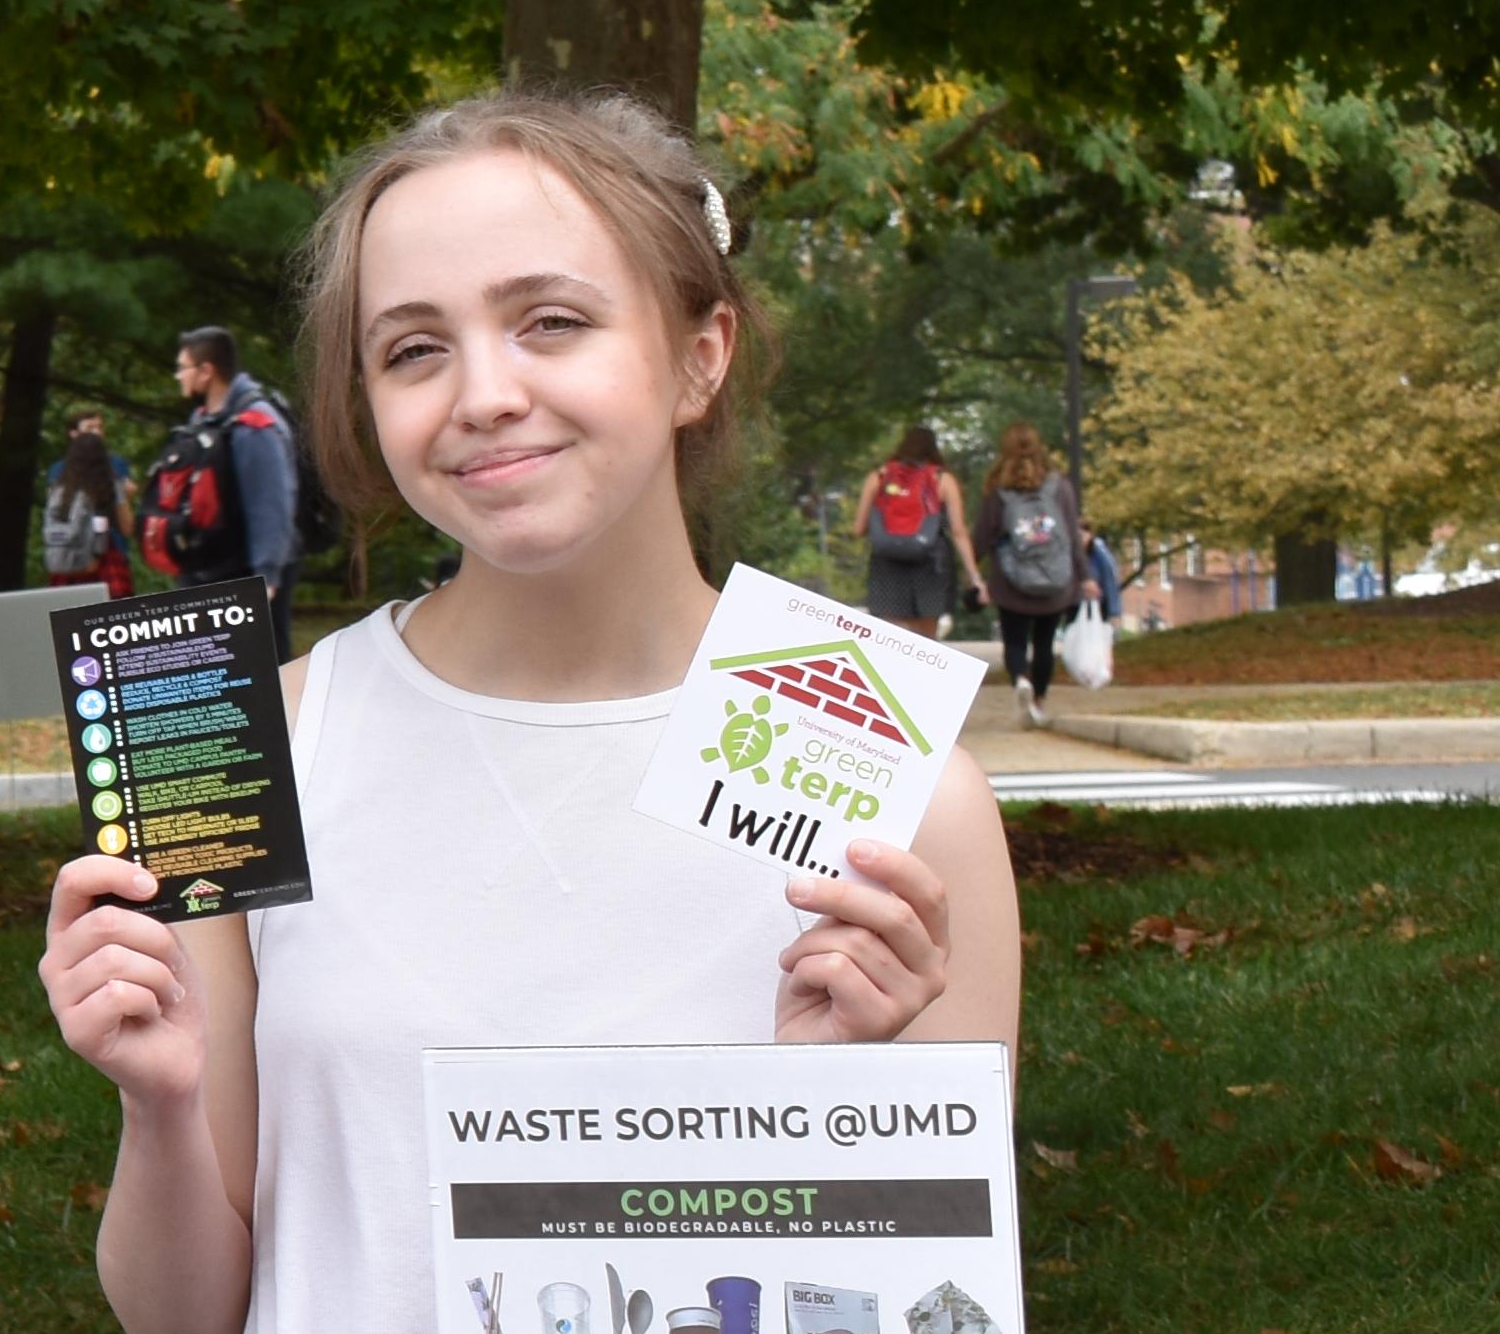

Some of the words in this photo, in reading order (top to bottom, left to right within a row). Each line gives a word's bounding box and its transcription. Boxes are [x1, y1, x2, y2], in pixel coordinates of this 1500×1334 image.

[72, 632, 81, 651] I
[90, 613, 200, 649] COMMIT
[206, 605, 254, 627] TO:
[109, 611, 141, 624] GREEN
[145, 605, 170, 617] TERP
[173, 595, 238, 613] COMMITMENT
[787, 598, 949, 670] greenterp.umd.edu
[797, 716, 846, 742] University
[856, 740, 901, 765] Maryland
[803, 738, 893, 789] green
[781, 755, 880, 822] terp
[698, 780, 724, 827] I
[729, 803, 840, 879] will...
[449, 1108, 602, 1143] WASTE
[615, 1105, 810, 1141] SORTING
[824, 1102, 978, 1147] @UMD
[620, 1187, 818, 1217] COMPOST
[541, 1221, 589, 1234] MUST
[596, 1221, 616, 1234] BE
[624, 1220, 781, 1235] BIODEGRADABLE,
[788, 1220, 813, 1234] NO
[822, 1219, 897, 1233] PLASTIC
[793, 1290, 812, 1303] BIG
[814, 1293, 835, 1305] BOX
